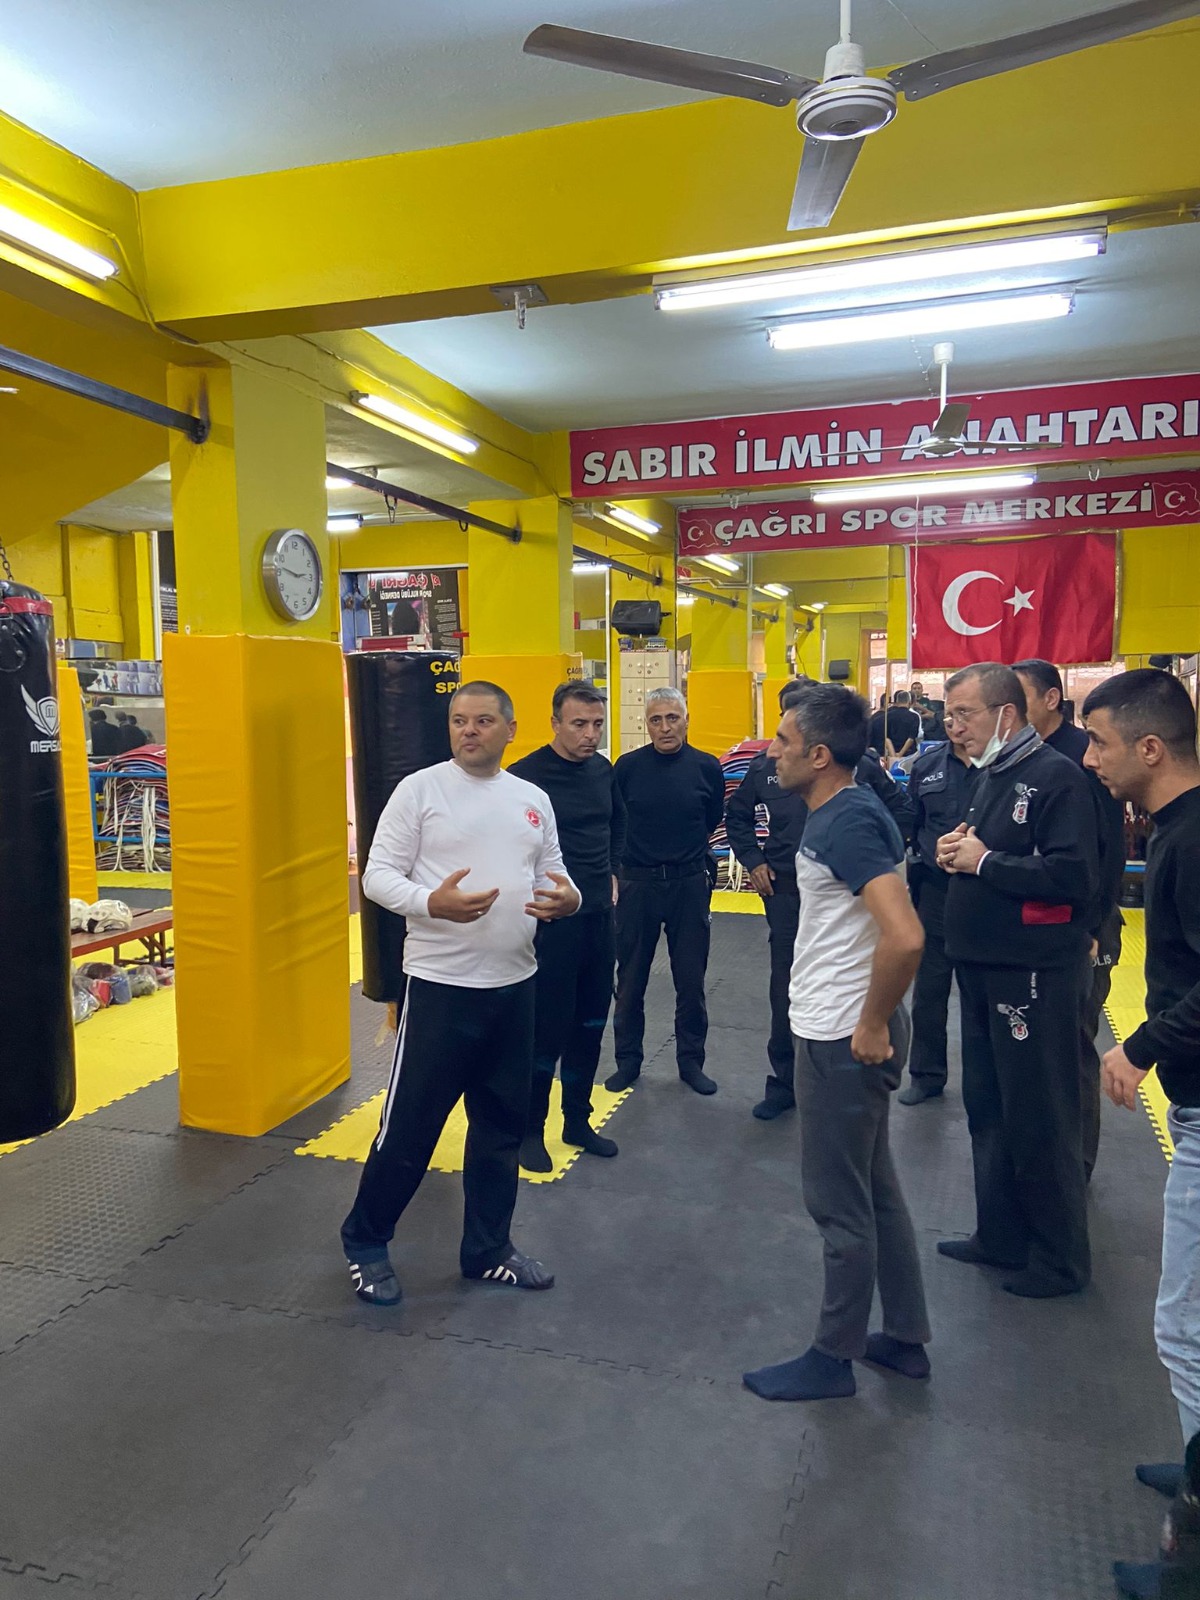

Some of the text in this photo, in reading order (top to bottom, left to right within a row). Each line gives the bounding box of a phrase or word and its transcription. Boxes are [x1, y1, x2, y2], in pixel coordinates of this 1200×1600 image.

[582, 443, 717, 485] SABIR
[735, 420, 883, 474] İLMİN
[292, 541, 298, 550] 12
[714, 482, 1153, 546] ÇAĞRI SPOR MERKEZİ
